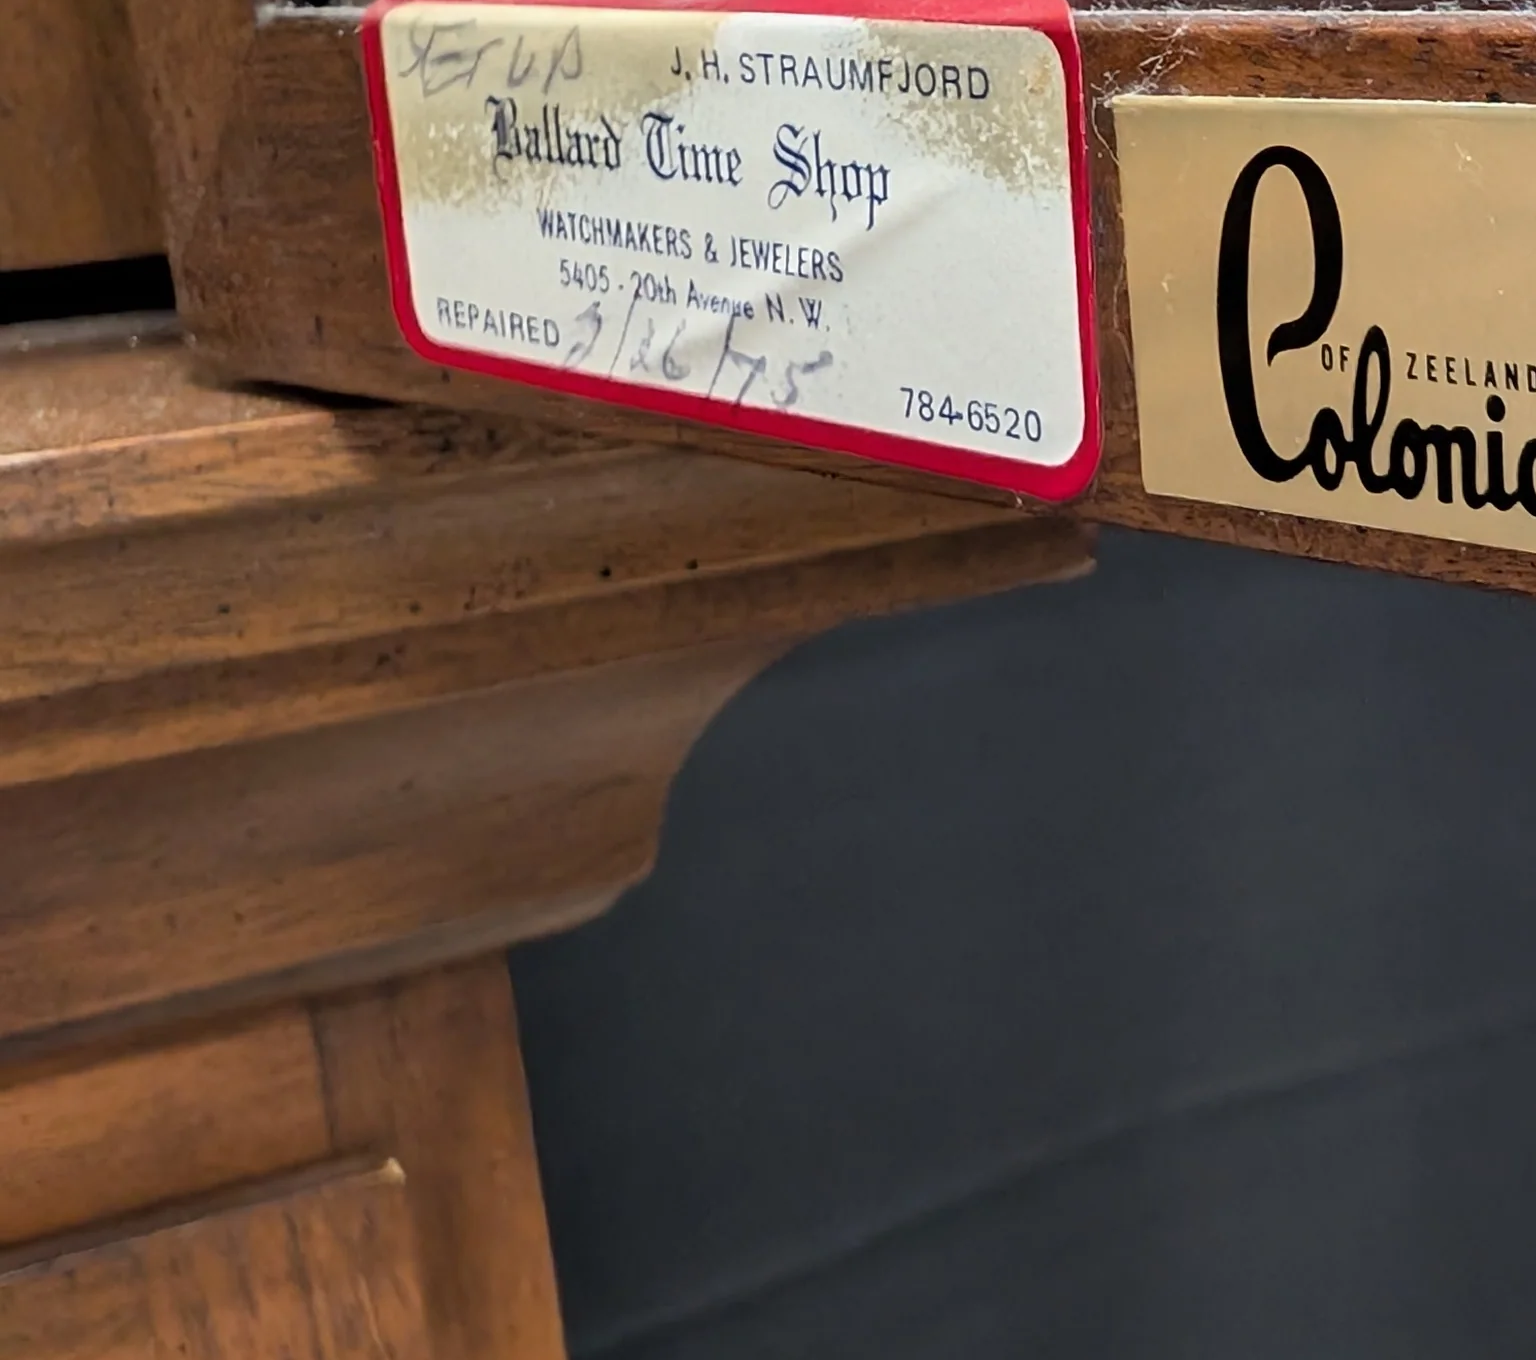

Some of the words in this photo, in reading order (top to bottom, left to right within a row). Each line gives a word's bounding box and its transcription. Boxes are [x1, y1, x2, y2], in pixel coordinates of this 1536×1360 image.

[740, 52, 990, 100] STRAUMFJORD
[484, 95, 622, 172] Ballard
[640, 111, 743, 186] Time
[768, 122, 892, 230] Shop
[536, 207, 693, 262] WATCHMAKERS
[704, 234, 719, 265] &
[729, 237, 845, 283] JEWELERS
[559, 259, 610, 295] 5405
[686, 278, 755, 321] Avenue
[435, 297, 562, 348] REPAIRED
[1320, 342, 1351, 374] OF
[899, 386, 1044, 443] 784-6520
